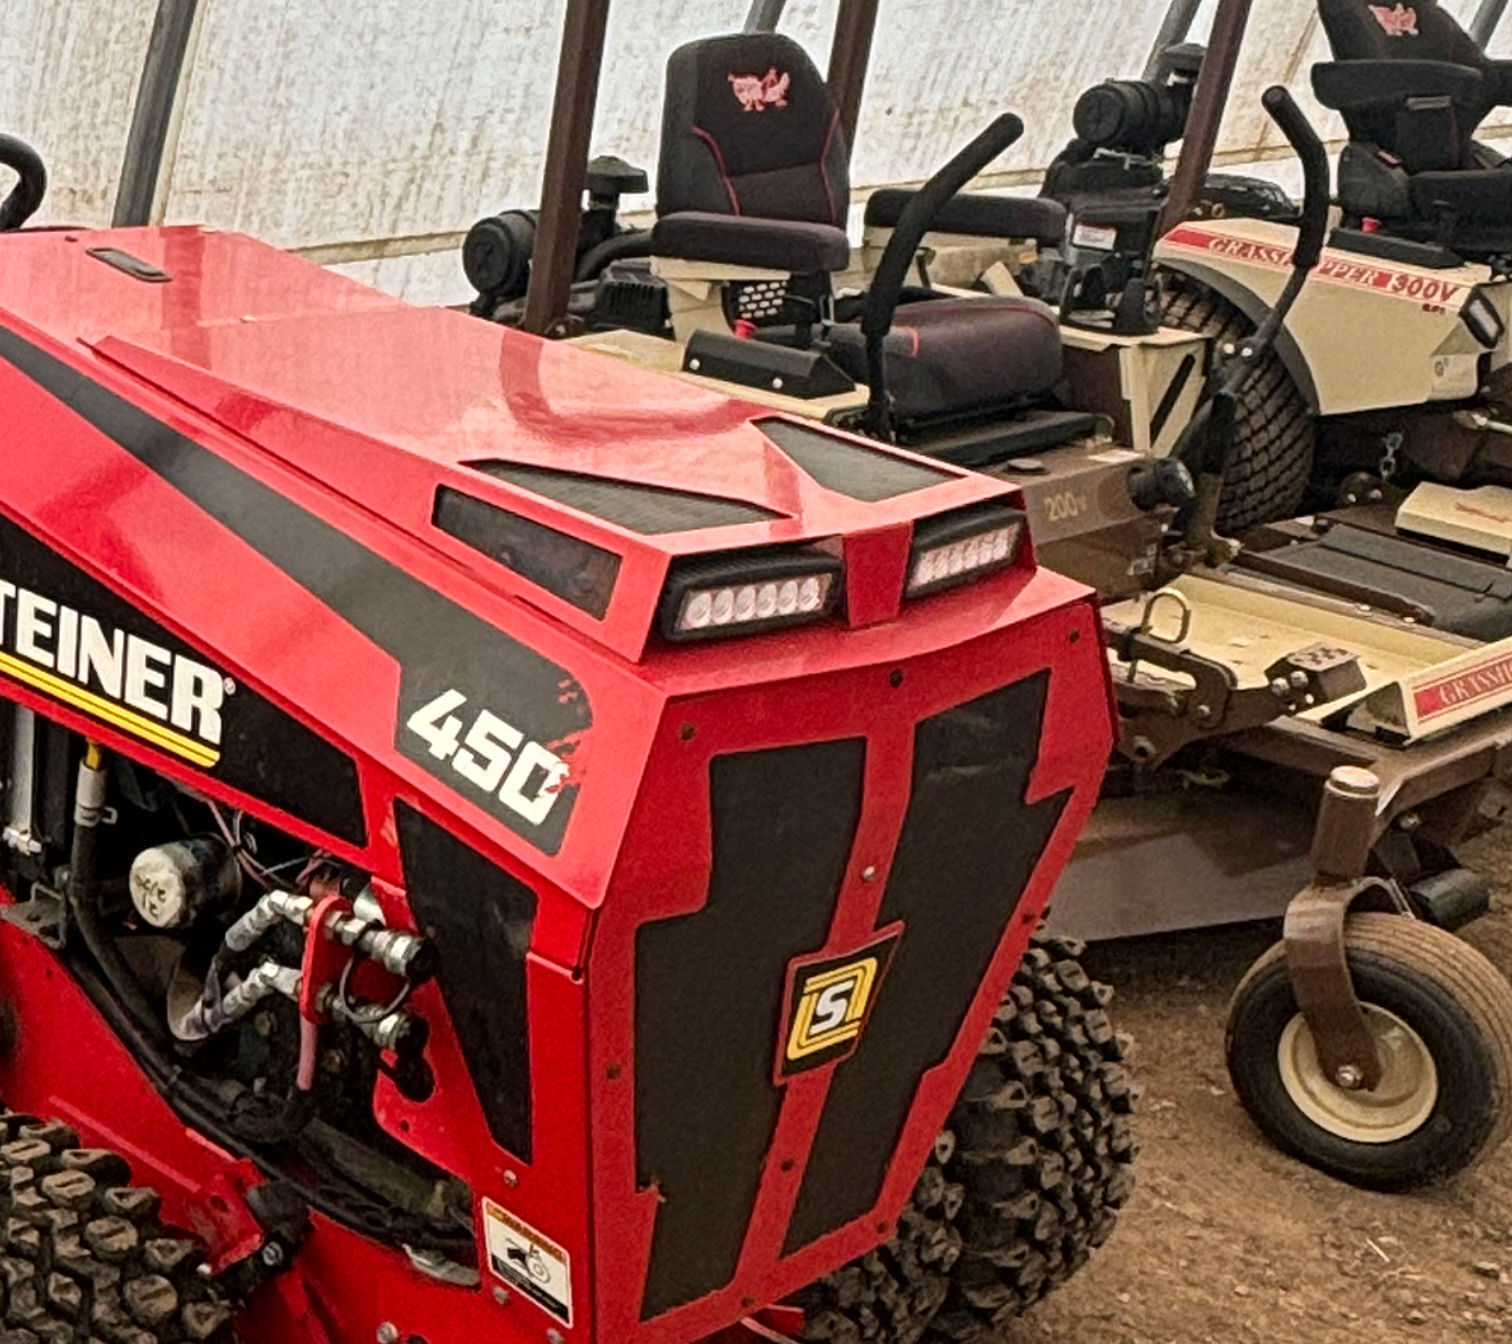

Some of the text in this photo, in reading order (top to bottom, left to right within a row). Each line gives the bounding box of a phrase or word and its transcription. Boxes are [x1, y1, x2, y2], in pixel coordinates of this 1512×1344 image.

[1208, 238, 1459, 302] GRASSPPER 300V
[406, 688, 570, 826] 450
[808, 979, 856, 1037] S
